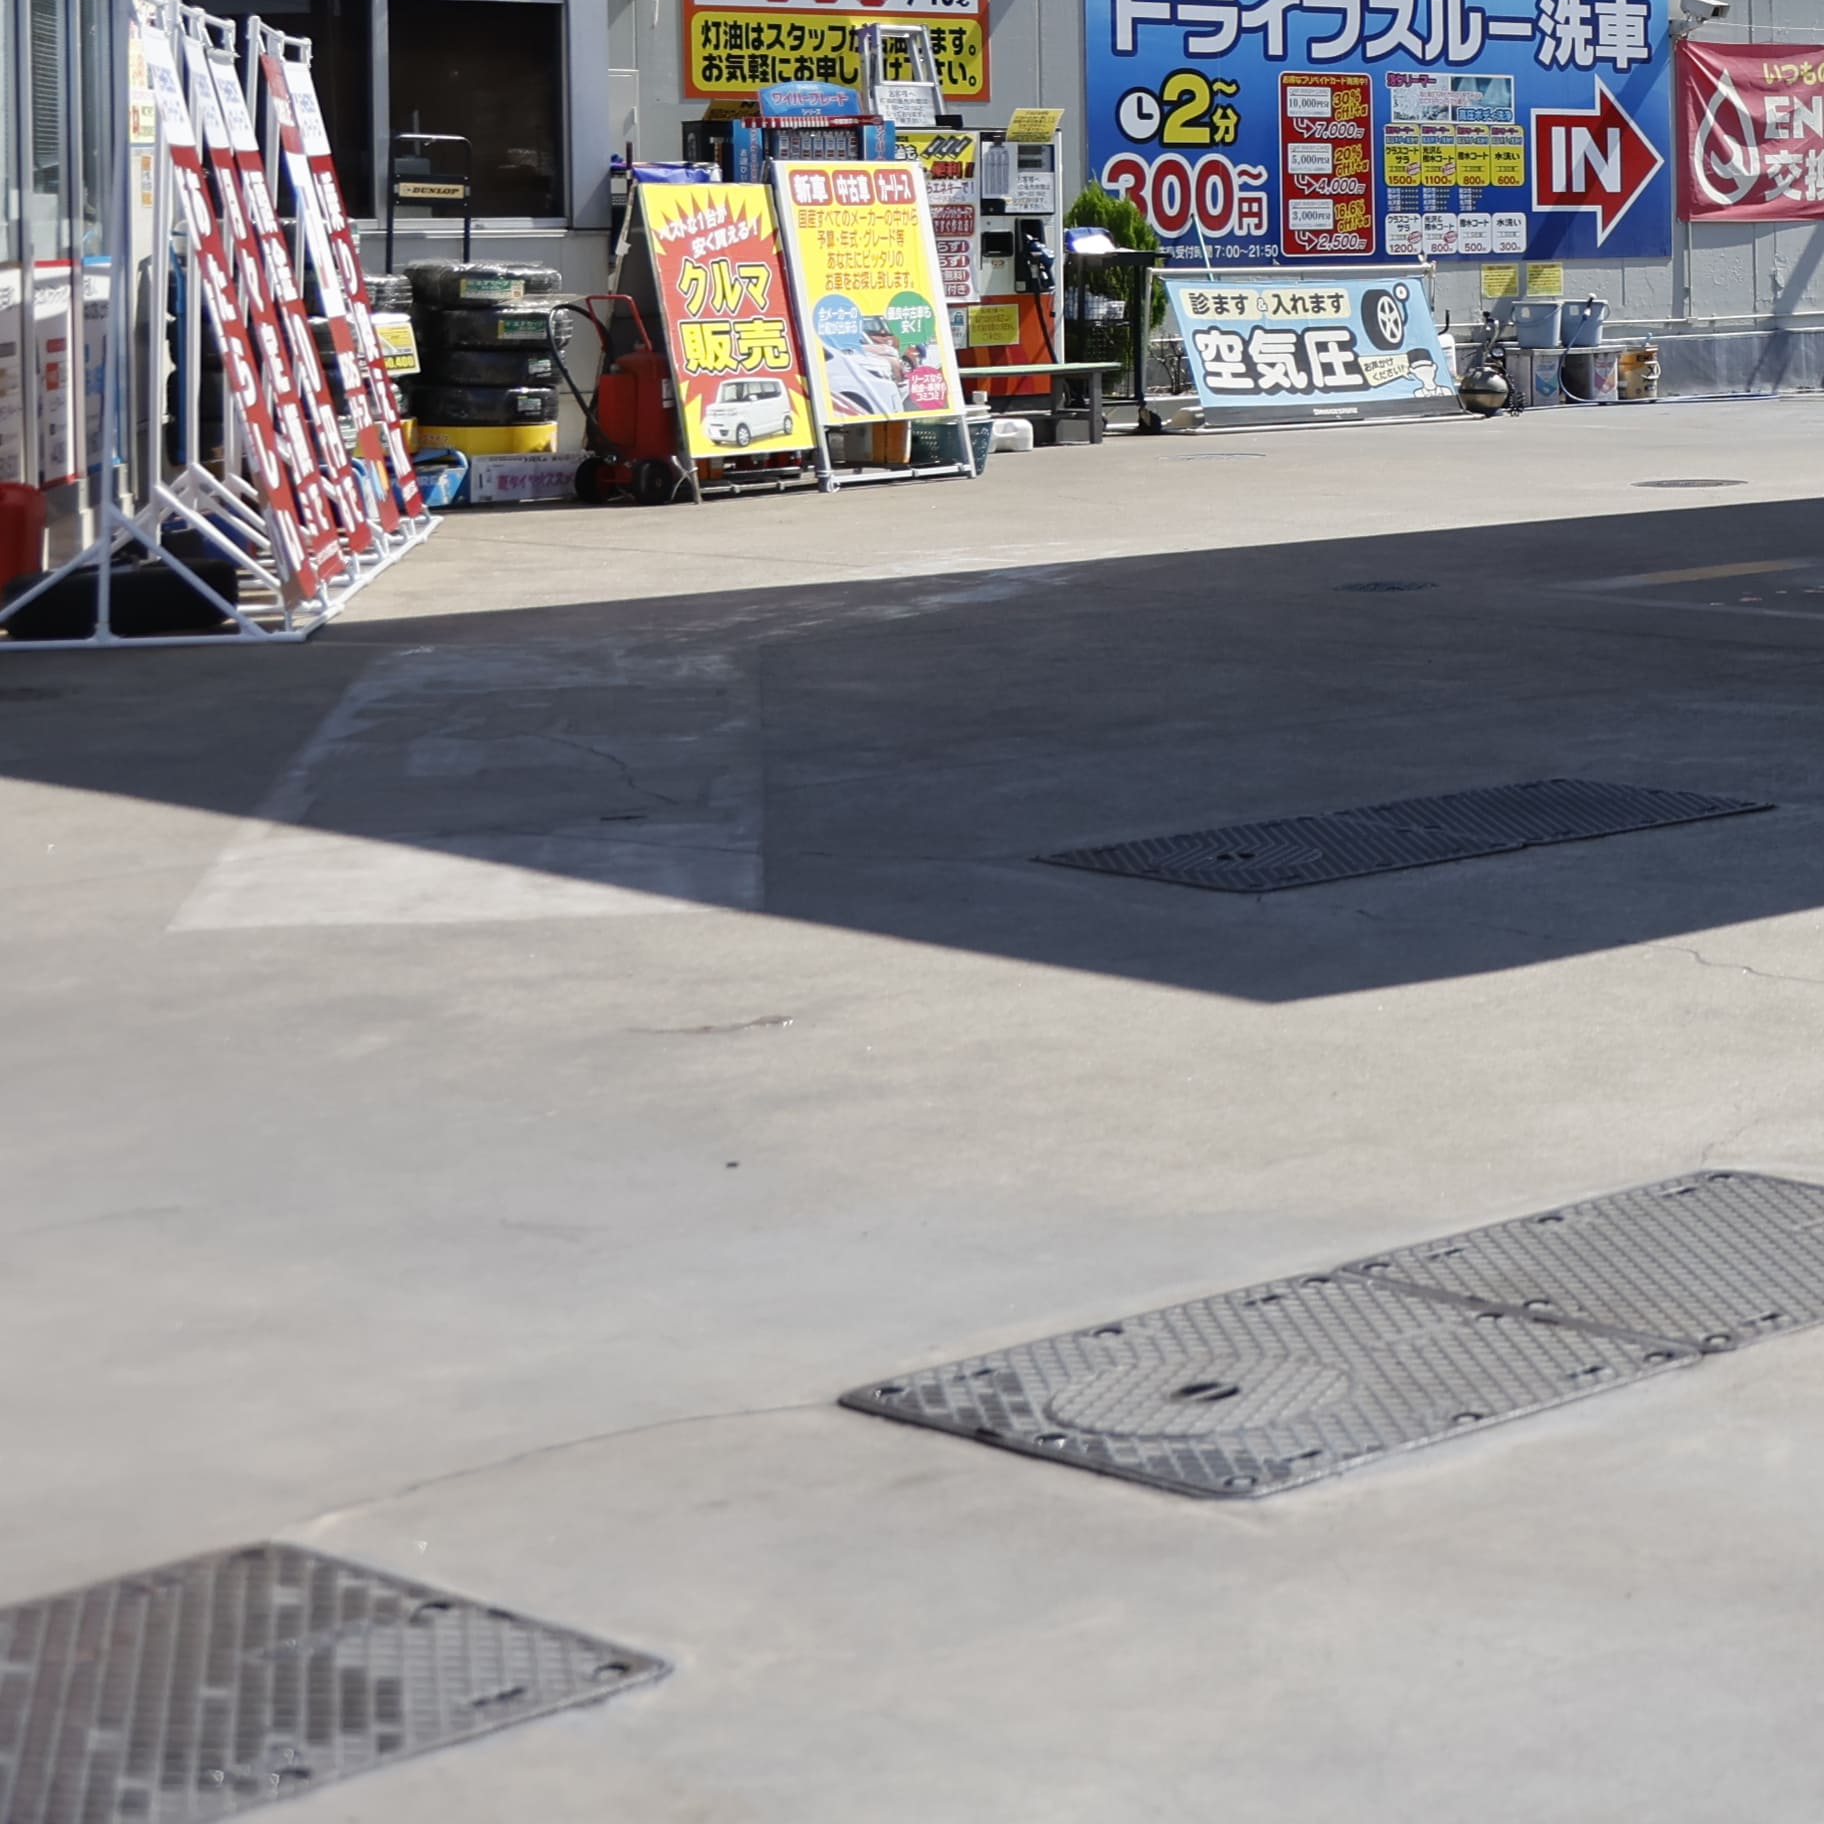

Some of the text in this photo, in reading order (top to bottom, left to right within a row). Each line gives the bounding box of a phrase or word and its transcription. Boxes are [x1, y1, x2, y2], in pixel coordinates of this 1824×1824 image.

[1333, 89, 1361, 108] 30%
[1550, 125, 1622, 194] IN
[412, 186, 459, 196] DUNLOP
[793, 174, 829, 203] 新車
[836, 175, 871, 202] 中古車
[678, 256, 772, 317] クルマ
[1188, 292, 1248, 316] 診ます
[1272, 292, 1345, 316] 入れます
[679, 317, 791, 373] 販売
[1193, 327, 1364, 392] 空気圧
